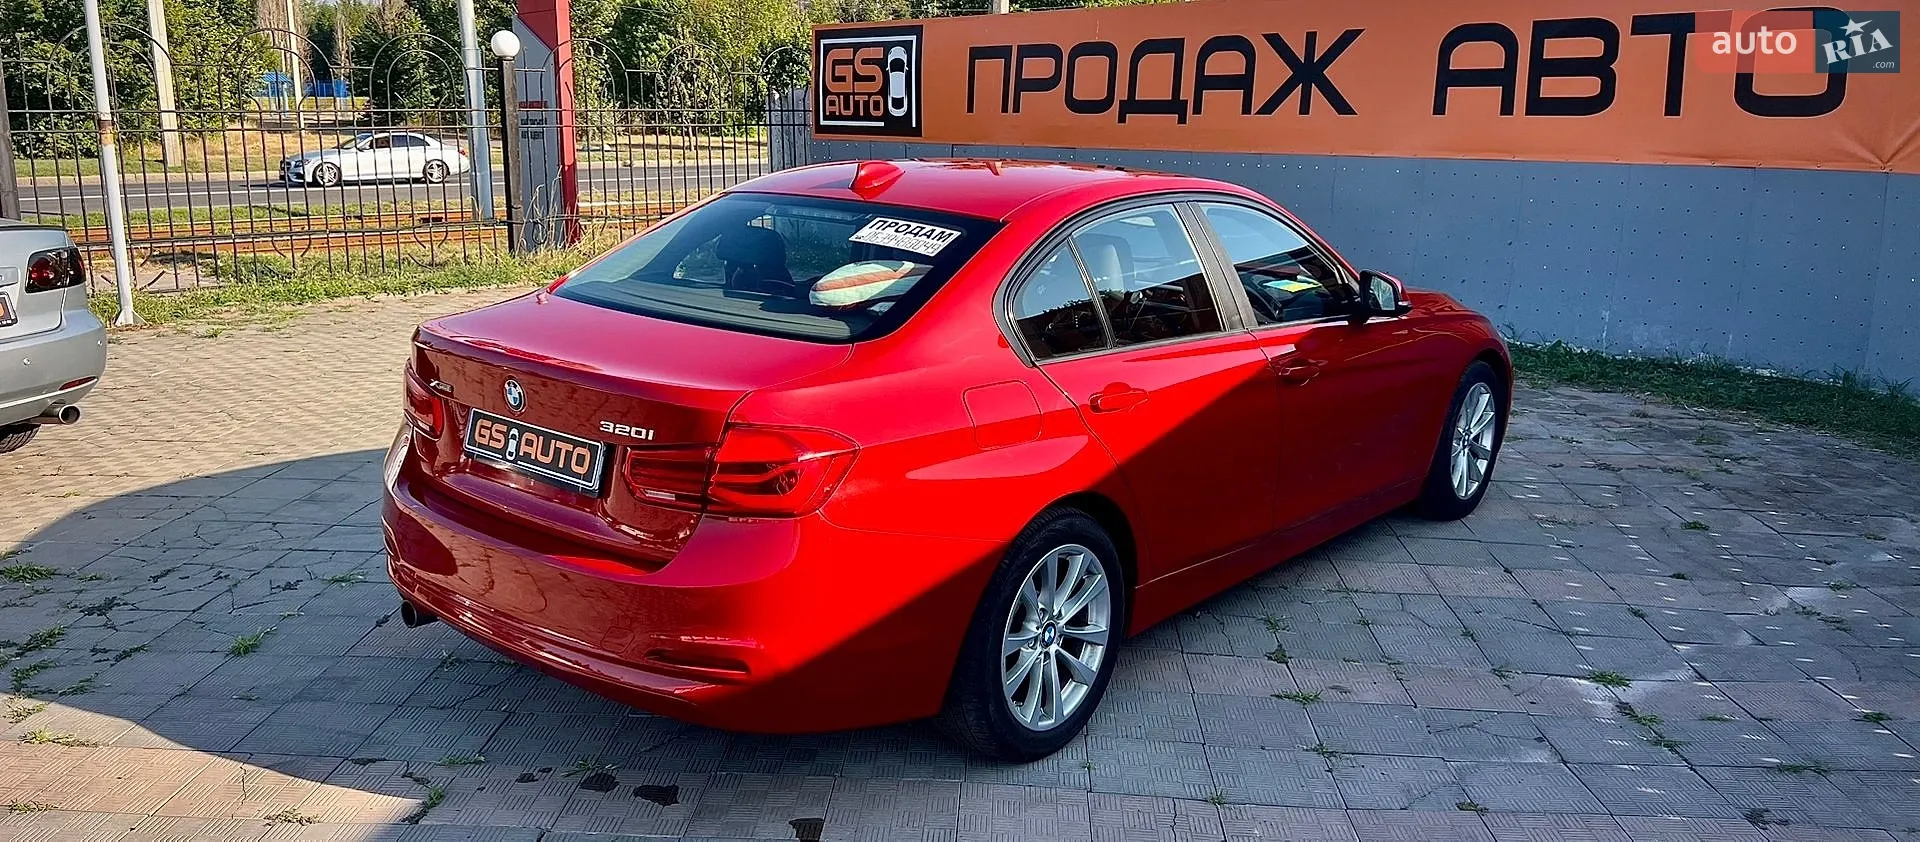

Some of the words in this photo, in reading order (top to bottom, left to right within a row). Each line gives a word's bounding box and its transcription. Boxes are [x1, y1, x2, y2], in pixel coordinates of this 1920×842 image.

[825, 47, 884, 93] GS
[966, 28, 1366, 125] ПРОДАЖ
[1431, 6, 1852, 119] АВТО
[825, 94, 884, 117] AUTO
[869, 219, 954, 243] ПРОДАМ
[474, 418, 507, 450] GS
[519, 434, 591, 476] AUTO
